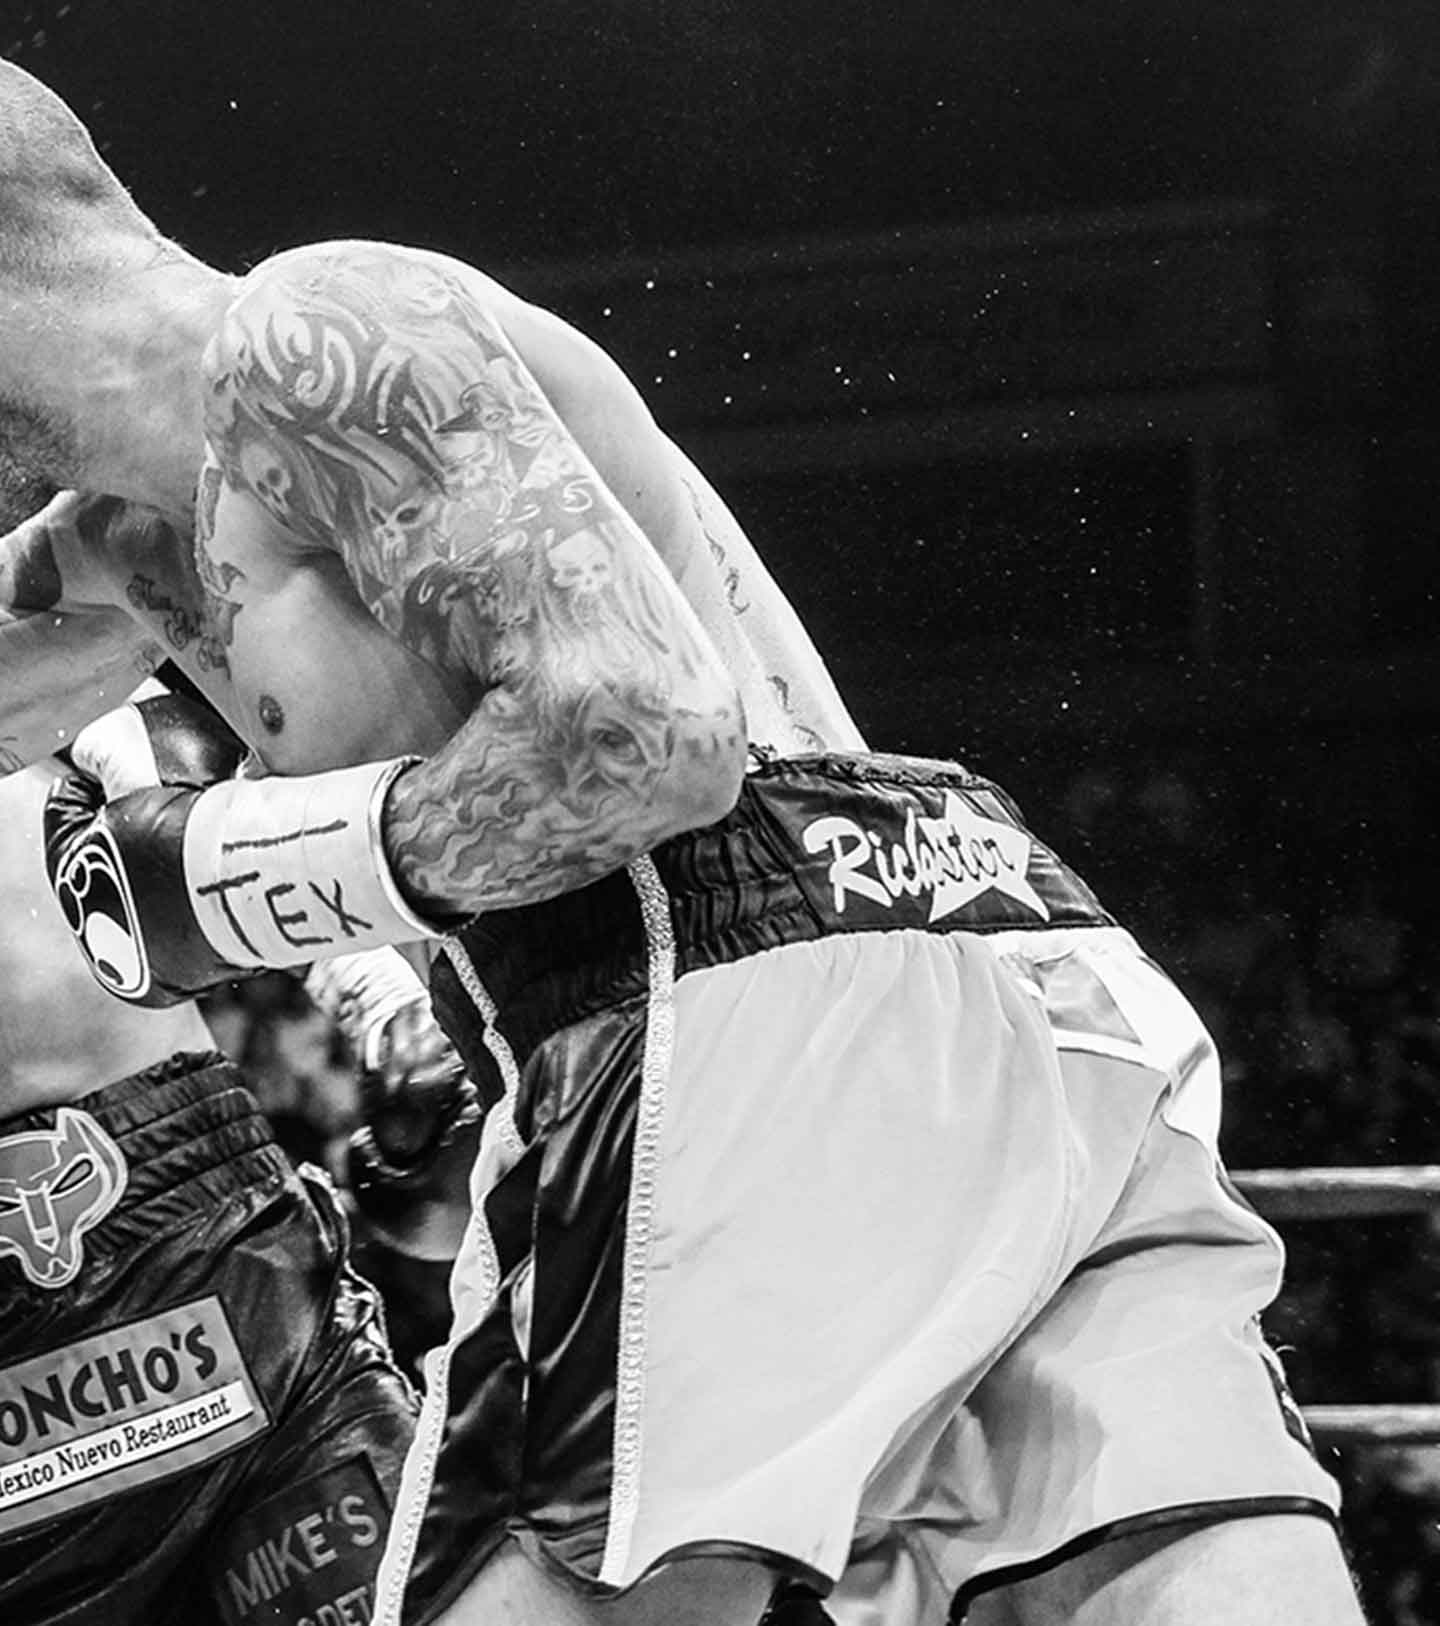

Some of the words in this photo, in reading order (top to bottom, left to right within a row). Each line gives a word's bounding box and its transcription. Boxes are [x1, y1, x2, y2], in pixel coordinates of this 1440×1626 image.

[196, 870, 372, 960] TEX
[59, 1440, 123, 1477] Nuevo
[125, 1393, 232, 1455] Restaurant
[224, 1494, 379, 1617] MIKE'S
